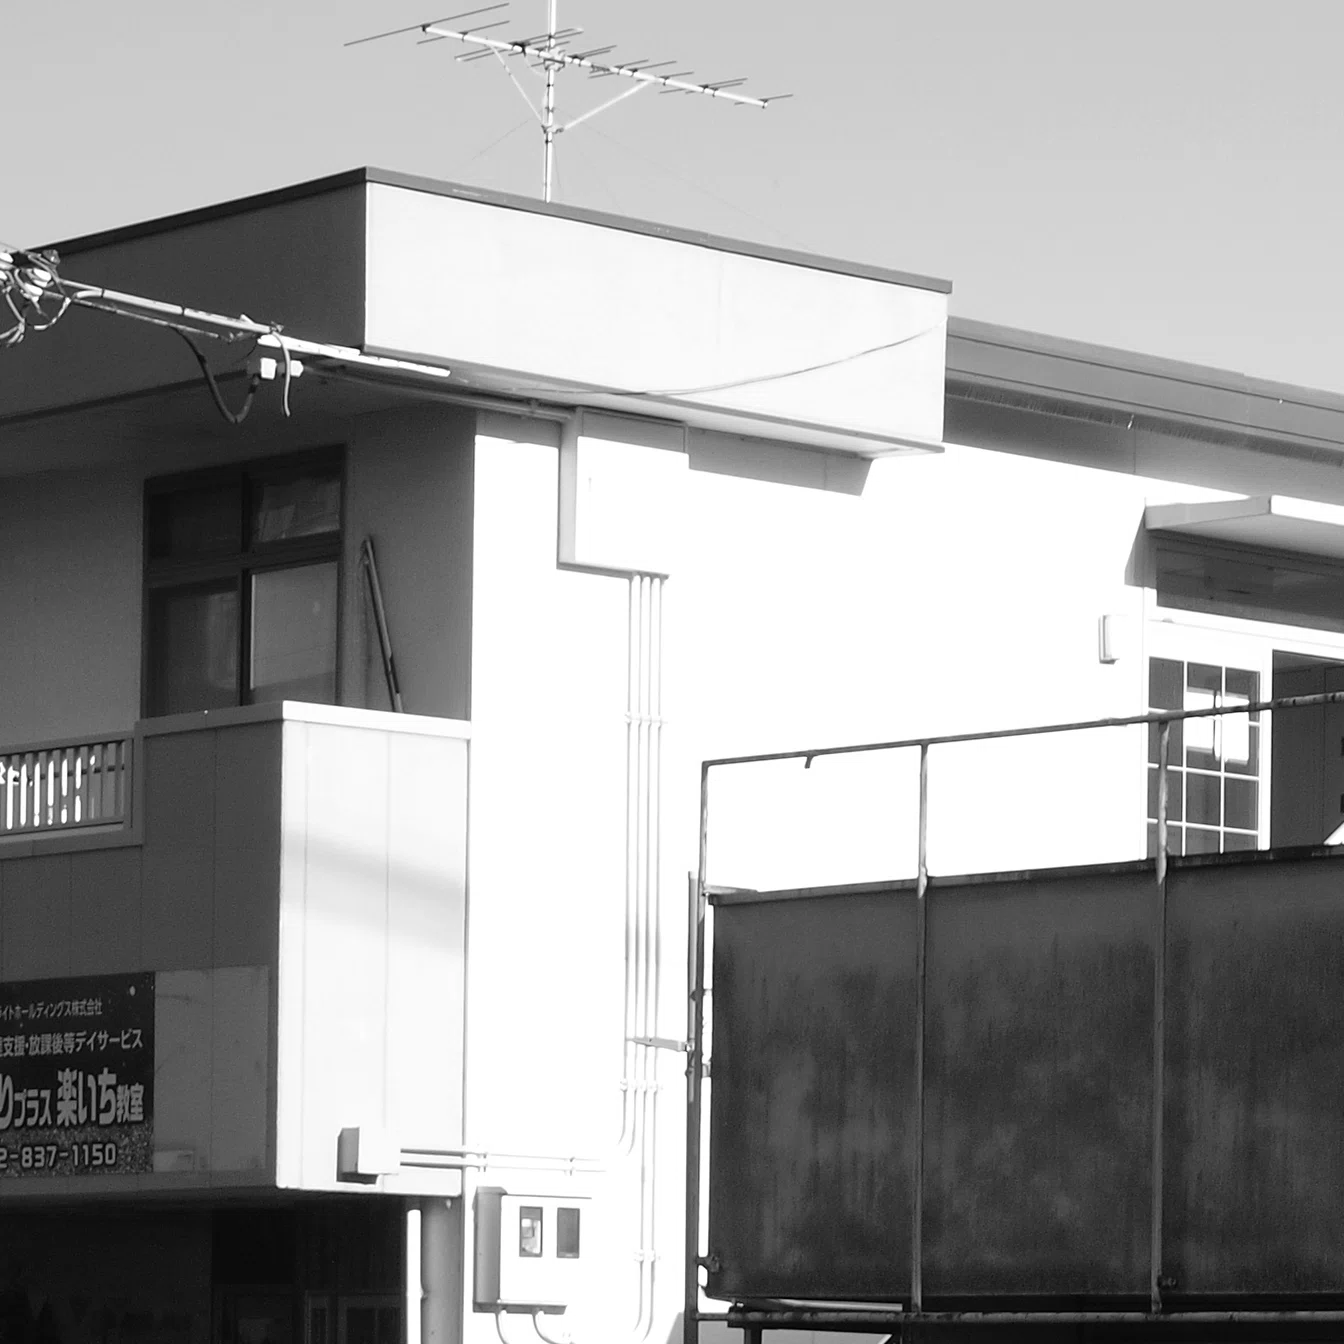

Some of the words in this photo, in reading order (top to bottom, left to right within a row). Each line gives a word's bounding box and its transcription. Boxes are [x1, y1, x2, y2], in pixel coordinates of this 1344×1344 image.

[0, 998, 103, 1021] イトホールディングス株式会社
[0, 1029, 144, 1058] 支援・放課後等デイサービス
[56, 1067, 144, 1127] 楽いち教室
